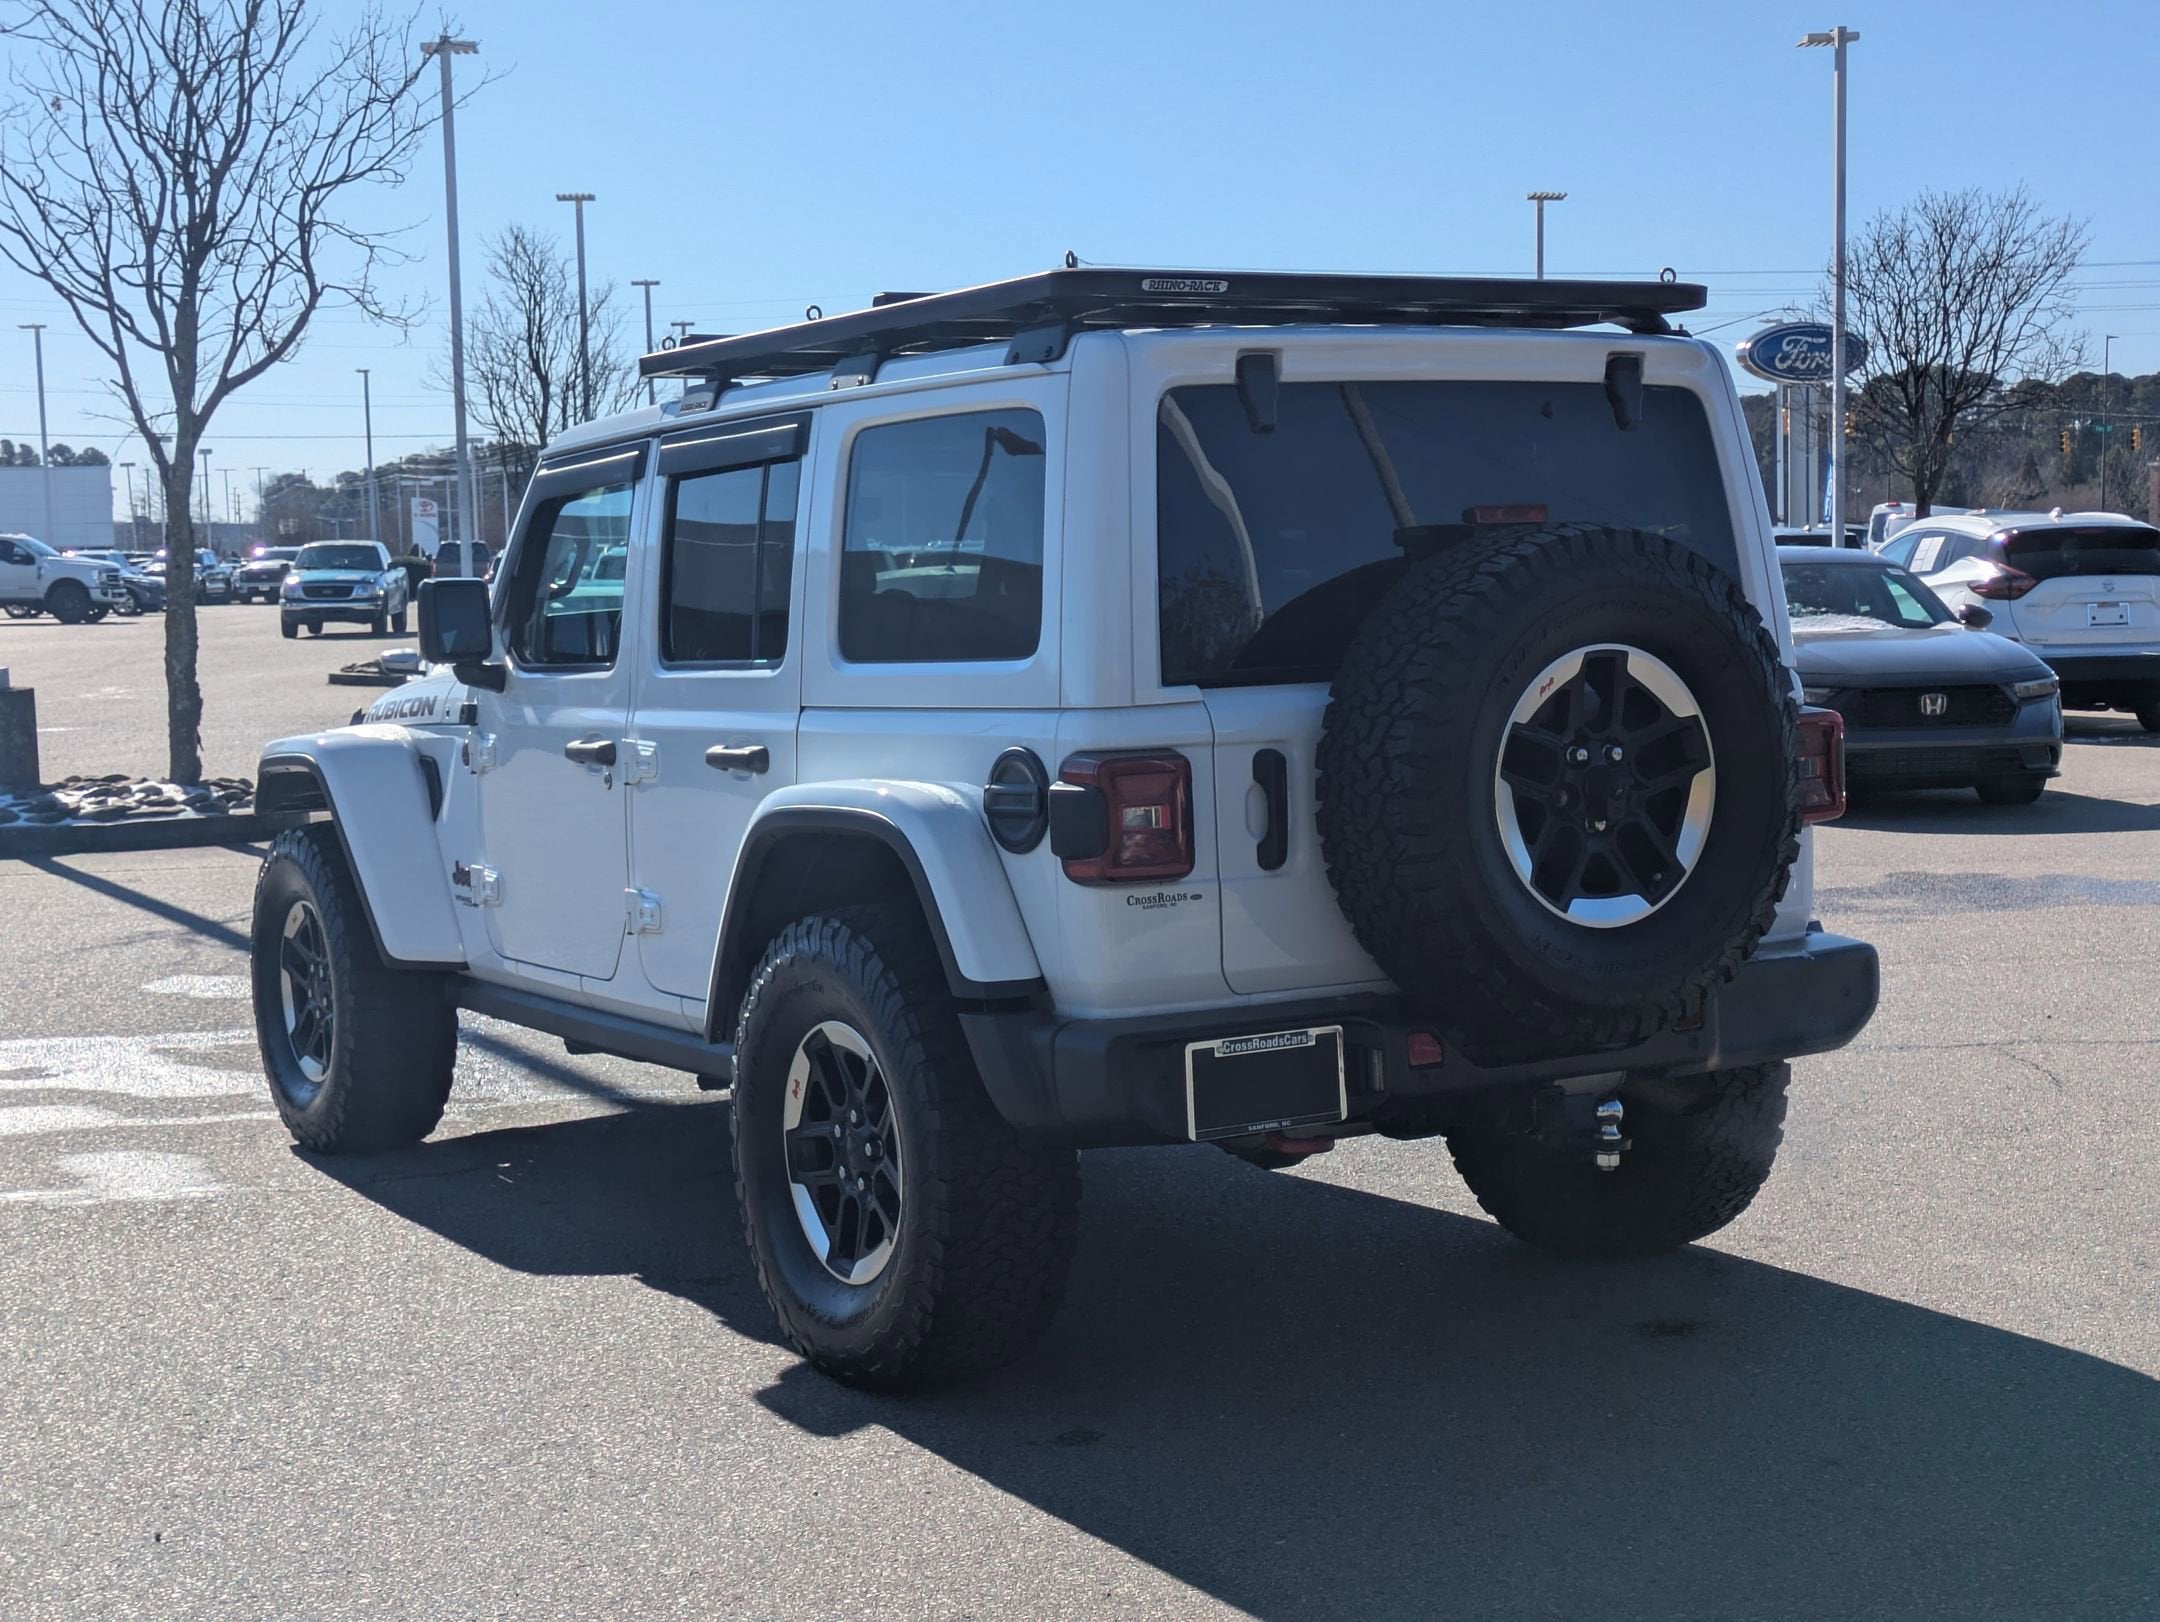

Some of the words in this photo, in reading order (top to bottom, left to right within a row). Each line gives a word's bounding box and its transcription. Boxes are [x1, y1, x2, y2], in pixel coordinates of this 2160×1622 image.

[1148, 280, 1220, 291] RHINO-RACK
[1775, 335, 1834, 370] For
[366, 696, 438, 722] RUBICON
[1223, 1033, 1307, 1053] CrossRoadsCars
